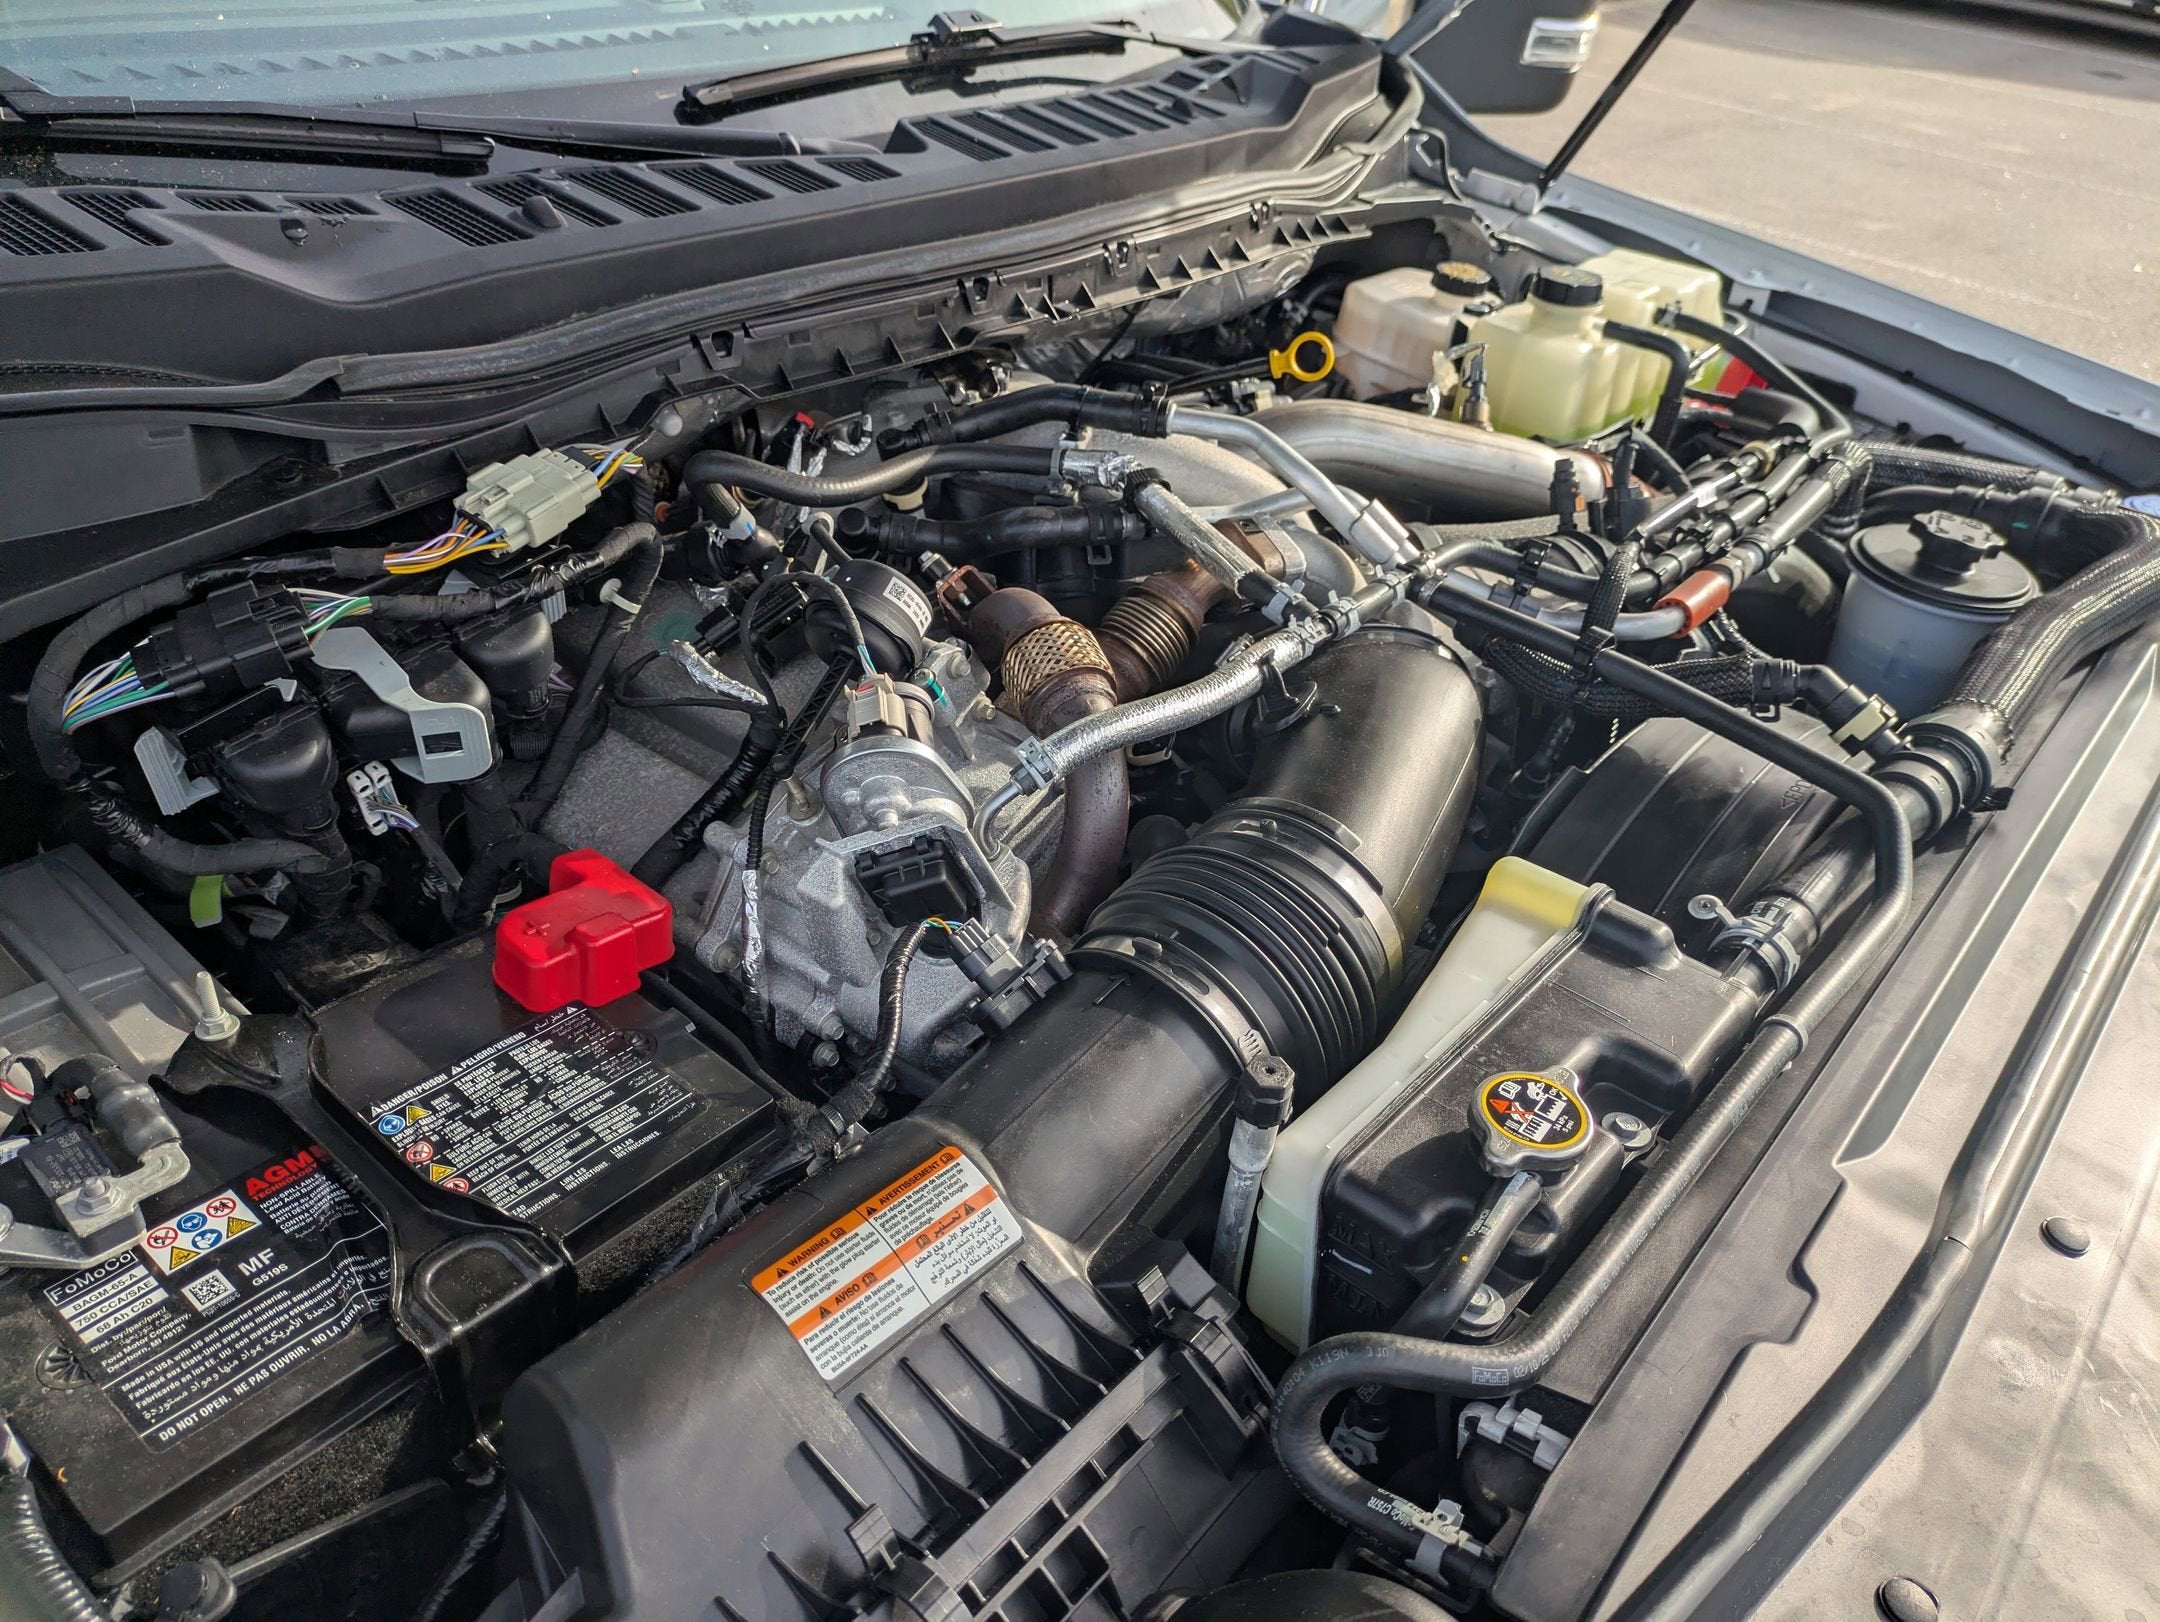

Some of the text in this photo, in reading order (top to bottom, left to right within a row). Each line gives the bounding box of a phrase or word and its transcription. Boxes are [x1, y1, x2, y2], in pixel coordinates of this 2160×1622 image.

[460, 1031, 526, 1068] PELIGRO/VENENO
[380, 1073, 447, 1110] DANGER/POISON
[609, 1137, 634, 1154] LEA LAS
[246, 1151, 312, 1195] AGM
[252, 1163, 316, 1200] TECHNOLOGY
[259, 1173, 320, 1209] NON-SPILLABLE
[559, 1166, 586, 1186] LIRE LES
[872, 1210, 887, 1222] Pour
[886, 1198, 907, 1213] réduire
[911, 1183, 929, 1196] risque
[934, 1161, 960, 1180] blessures
[878, 1160, 939, 1204] AVERTISSEMENT
[263, 1175, 326, 1213] Lead Acid Battery
[510, 1204, 526, 1216] EAD
[238, 1248, 273, 1275] MF
[765, 1231, 859, 1296] To reduce risk of possible serious
[787, 1237, 829, 1266] WARNING
[790, 1283, 798, 1291] or
[797, 1271, 816, 1286] death:
[814, 1265, 826, 1274] Do
[824, 1258, 835, 1268] not
[833, 1251, 845, 1261] use
[843, 1240, 861, 1254] starter
[859, 1230, 875, 1242] fluids
[50, 1252, 131, 1301] FoMoCo
[71, 1273, 138, 1311] BAGM-65-A
[252, 1263, 287, 1286] G519S
[778, 1237, 880, 1311] (such as ether) with the glow plug starter
[75, 1280, 153, 1326] 750 CCA/SAE
[784, 1278, 837, 1317] assist on the engine.
[803, 1277, 895, 1345] Para reducir el riesgo de lesiones
[834, 1283, 860, 1305] AVISO
[95, 1297, 153, 1333] 68 Ah C20
[90, 1339, 112, 1353] Dist.
[100, 1351, 123, 1367] Ford
[122, 1336, 148, 1353] Motor
[148, 1313, 191, 1339] Company,
[106, 1346, 150, 1373] Dearborn,
[149, 1337, 162, 1347] MI
[162, 1323, 186, 1340] 48121
[121, 1289, 290, 1391] Made in USA with US and imported materials.
[128, 1375, 165, 1400] Fabriqué
[165, 1367, 181, 1378] aux
[180, 1342, 221, 1369] États-Unis
[221, 1330, 240, 1344] avec
[239, 1321, 255, 1332] des
[254, 1299, 291, 1323] matériaux
[291, 1277, 331, 1302] américains
[135, 1380, 180, 1408] Fabricardo
[180, 1373, 192, 1382] en
[190, 1365, 205, 1376] los
[203, 1357, 219, 1368] EE.
[218, 1347, 234, 1359] UU.
[234, 1337, 249, 1349] con
[249, 1313, 289, 1339] materiales
[1472, 1366, 1508, 1385] FoMoCo
[158, 1426, 176, 1440] DO
[175, 1412, 198, 1430] NOT
[199, 1395, 231, 1416] OPEN.
[233, 1381, 249, 1395] NE
[247, 1368, 269, 1385] PAS
[268, 1345, 309, 1372] OUVRIR.
[310, 1332, 327, 1345] NO
[325, 1324, 341, 1337] LA
